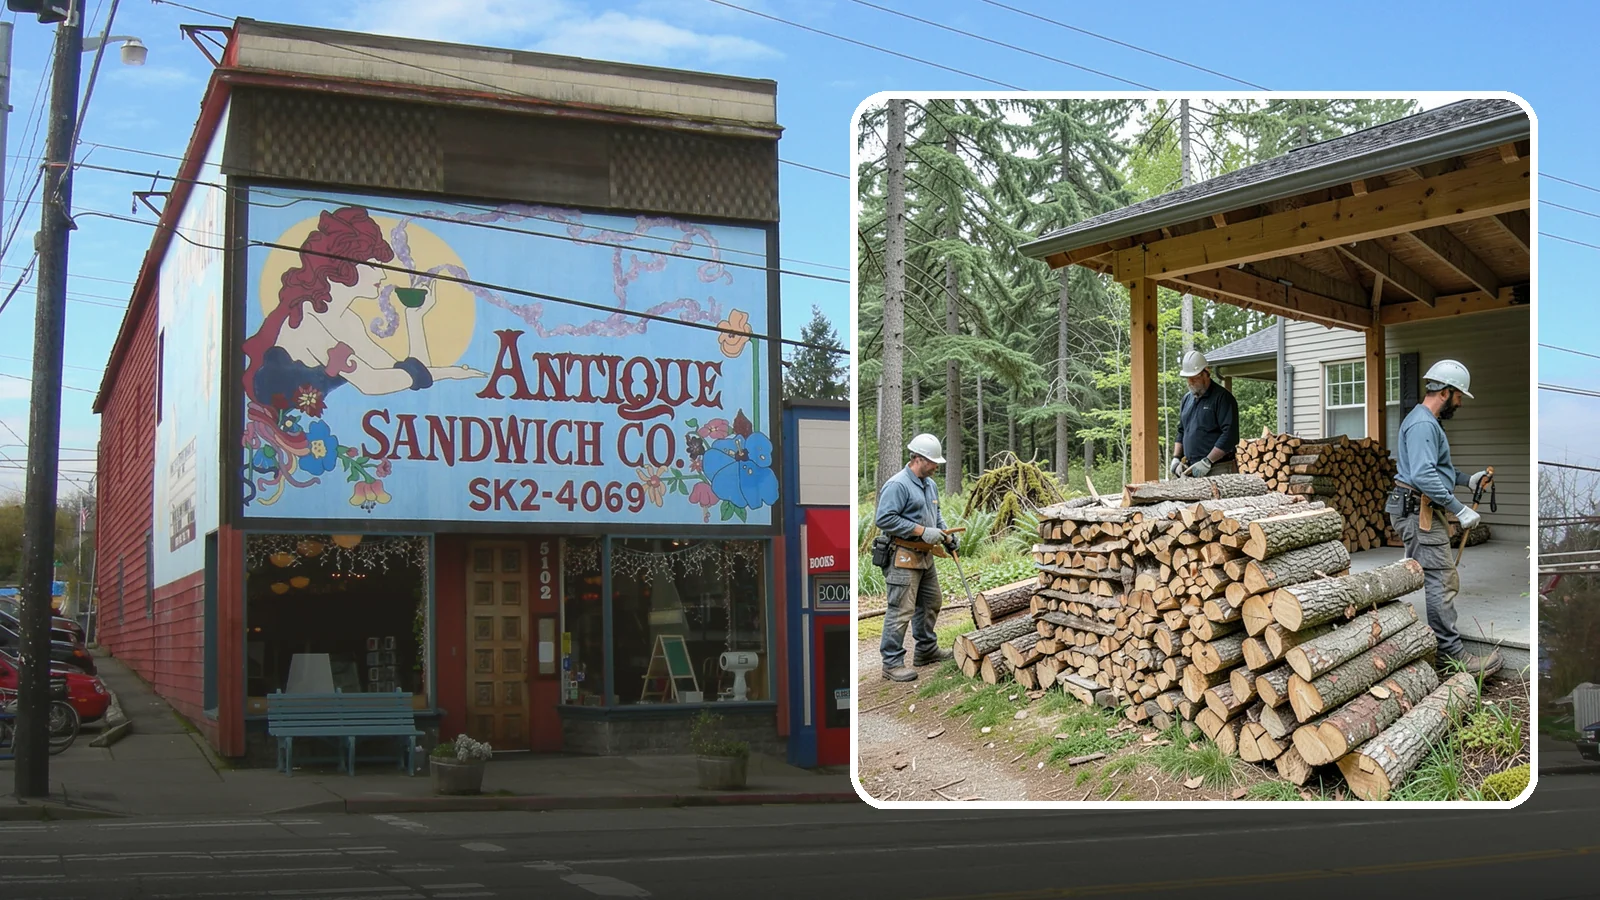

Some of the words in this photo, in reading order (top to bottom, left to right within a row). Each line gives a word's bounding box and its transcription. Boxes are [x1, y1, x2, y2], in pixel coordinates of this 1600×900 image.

[476, 329, 723, 421] ANTIQUE
[361, 409, 604, 467] SANDWICH
[617, 422, 685, 468] CO.
[468, 477, 645, 512] SK2-4069
[539, 541, 552, 599] 5102
[809, 555, 834, 569] BOOKS
